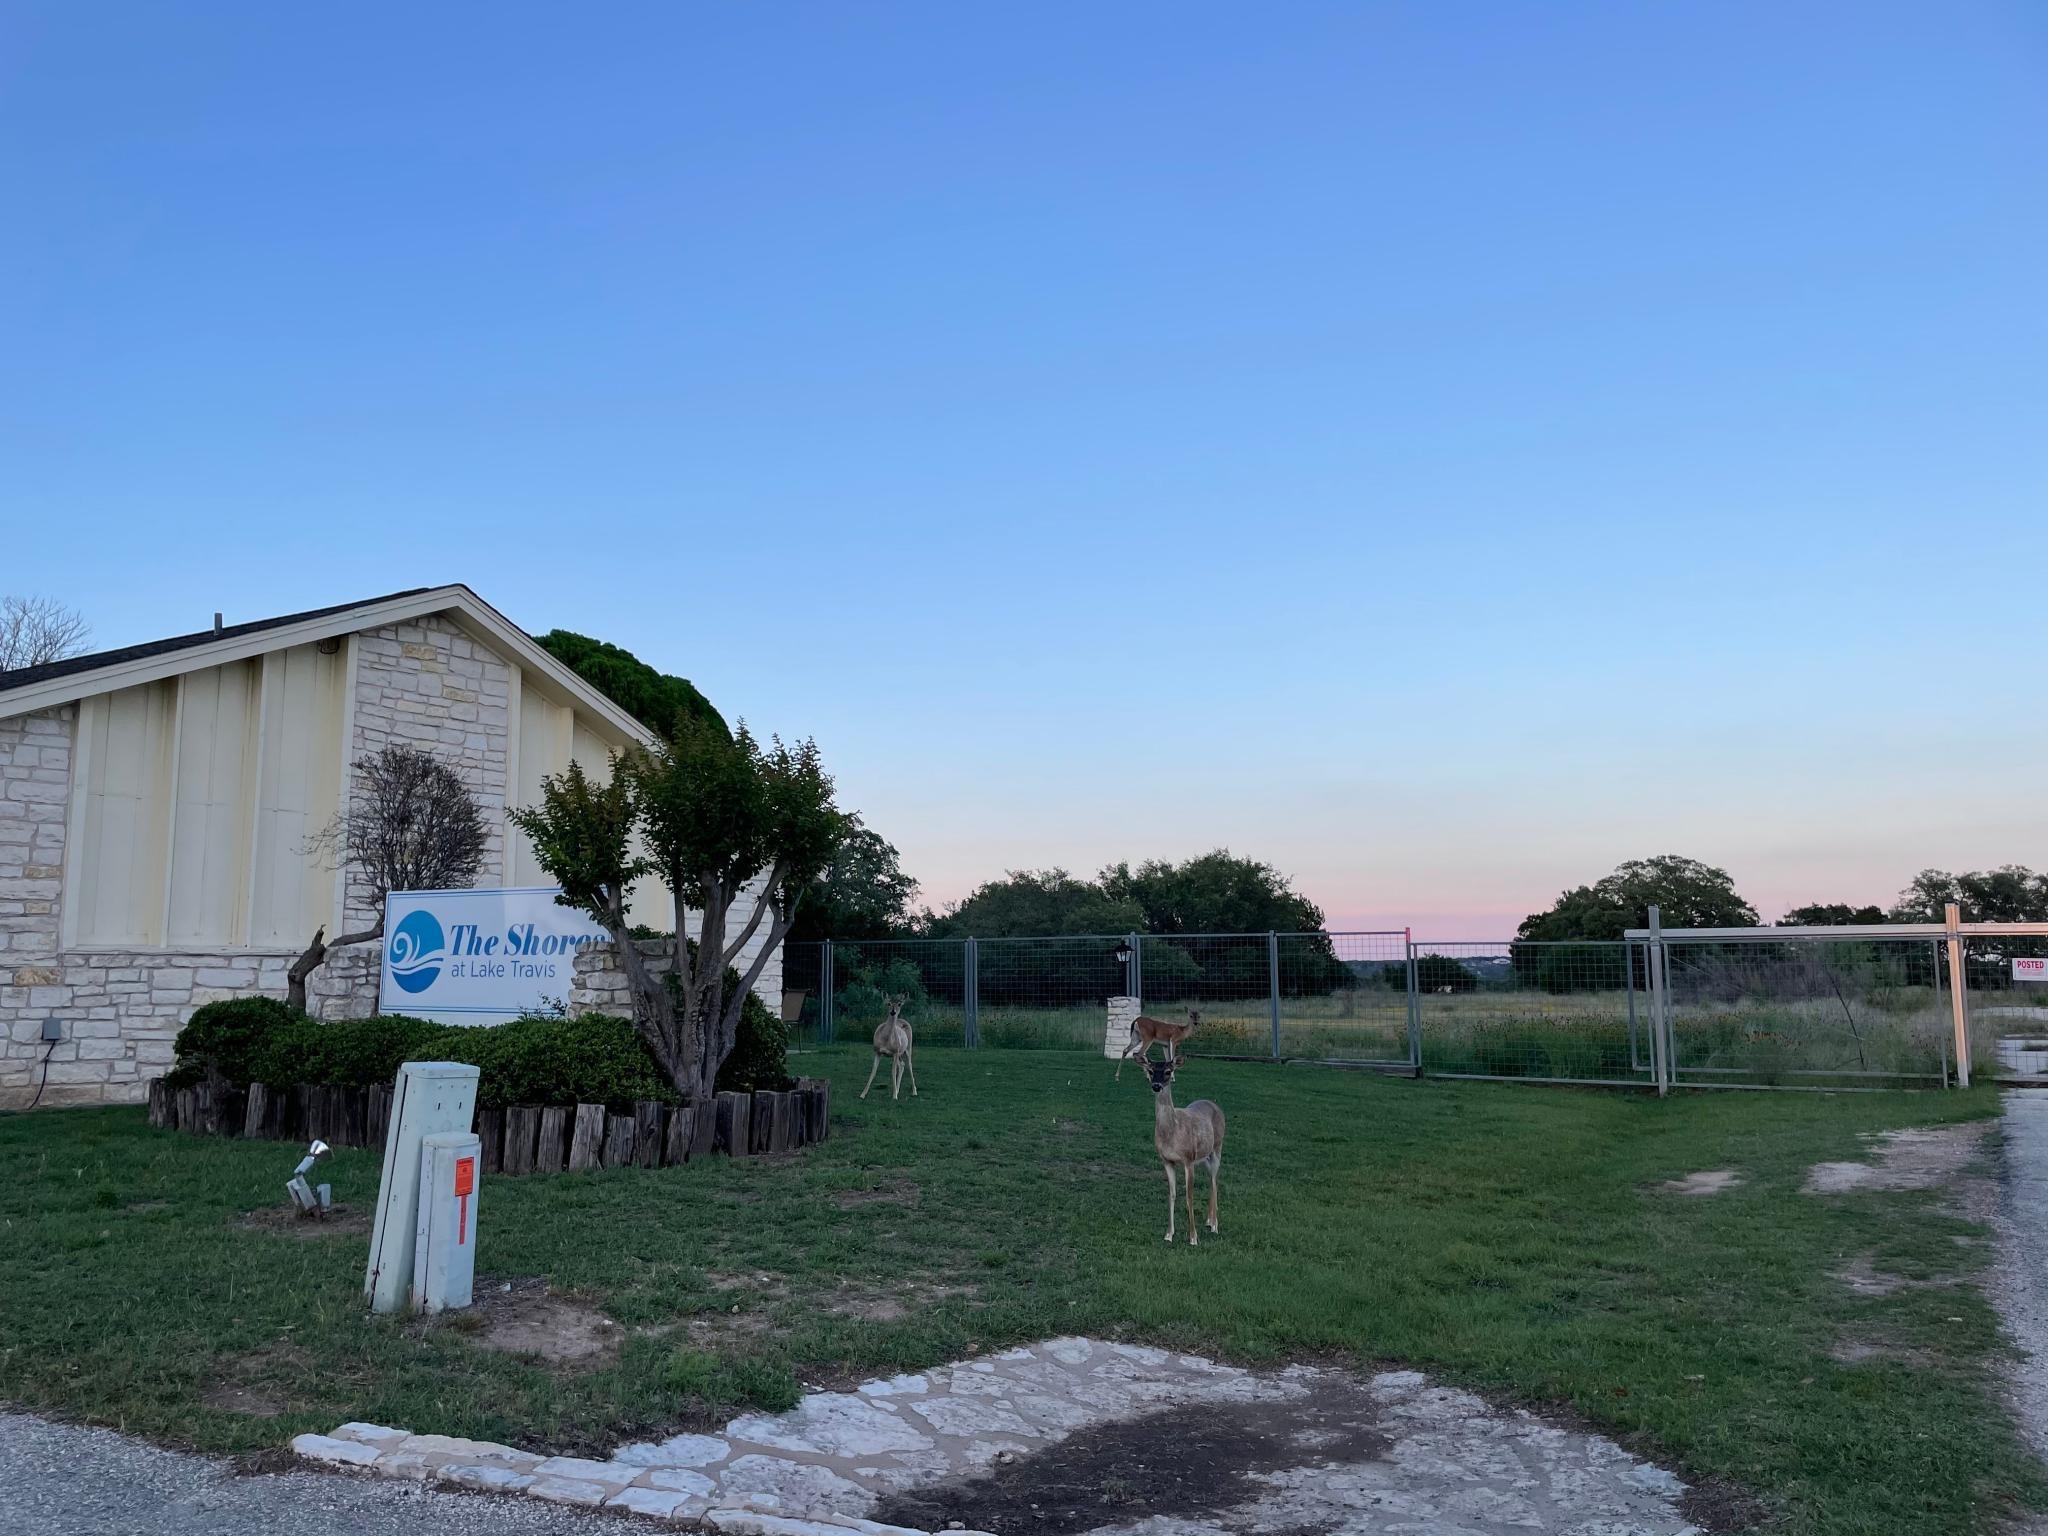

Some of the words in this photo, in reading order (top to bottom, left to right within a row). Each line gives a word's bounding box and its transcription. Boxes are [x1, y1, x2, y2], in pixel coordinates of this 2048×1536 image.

[450, 924, 500, 956] The
[451, 962, 466, 978] at
[470, 960, 505, 978] Lake
[510, 959, 556, 978] Travis
[2016, 960, 2044, 969] POSTED
